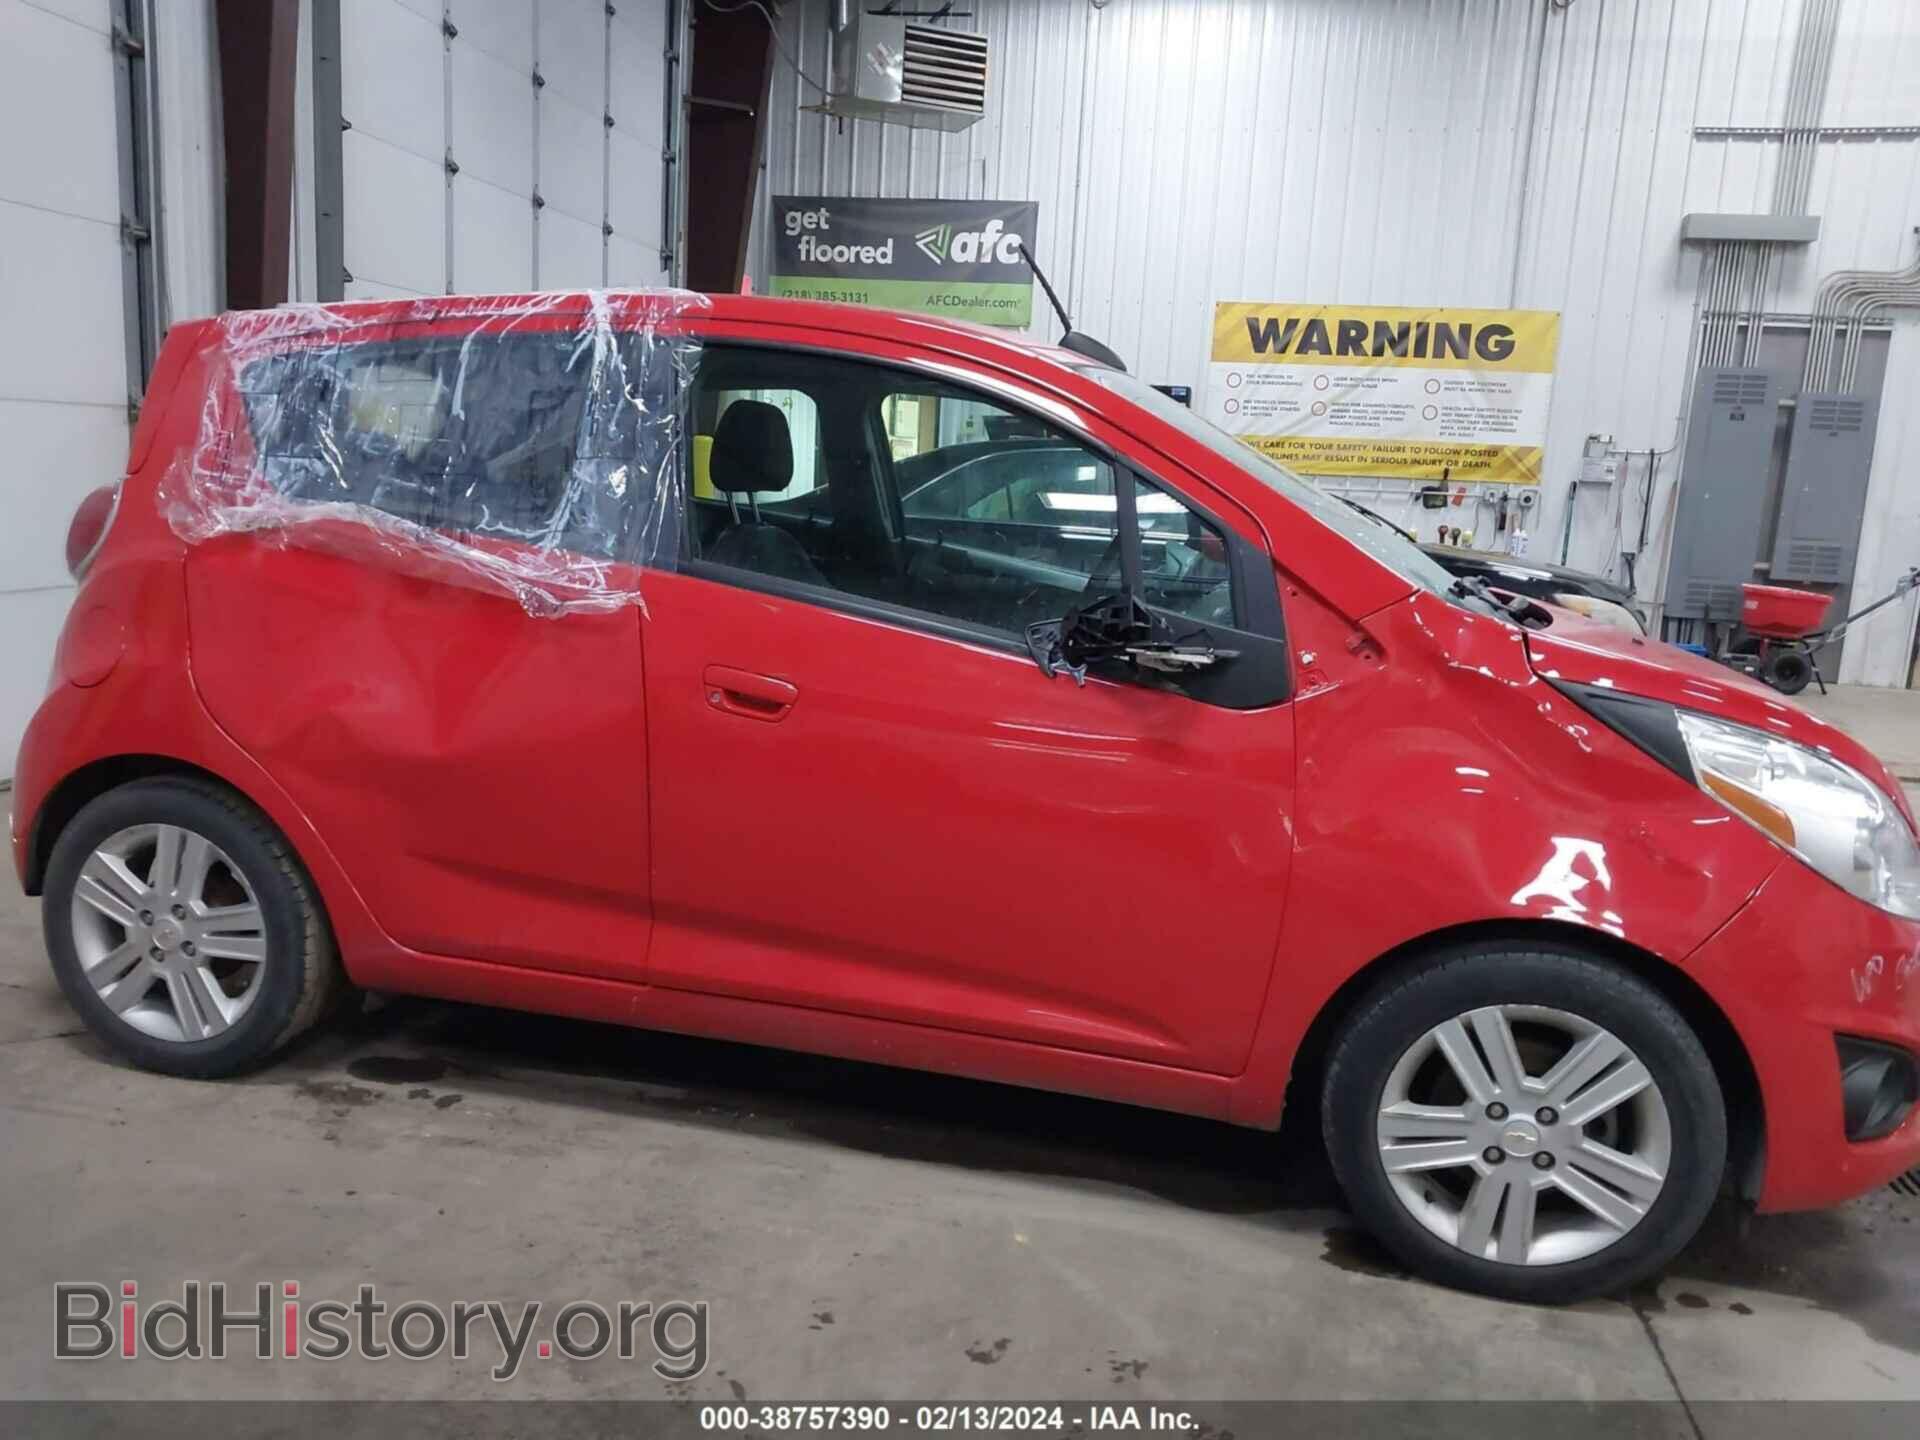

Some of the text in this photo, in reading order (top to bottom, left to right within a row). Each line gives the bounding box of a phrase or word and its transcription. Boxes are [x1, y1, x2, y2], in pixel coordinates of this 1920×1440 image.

[785, 207, 830, 236] get
[798, 235, 894, 265] floored
[815, 290, 869, 303] 385-3131
[926, 295, 1017, 308] AFCDealer.com
[1246, 316, 1516, 362] WARNING
[1263, 440, 1285, 449] CARE
[1288, 441, 1306, 449] FOR
[1309, 442, 1334, 451] YOUR
[1372, 444, 1406, 454] FAILURE
[1409, 446, 1422, 455] TO
[1424, 446, 1461, 456] FOLLOW
[1463, 449, 1498, 458] POSTED
[1302, 453, 1322, 461] MAY
[1325, 454, 1355, 463] RESULT
[1359, 455, 1368, 463] IN
[1371, 456, 1408, 465] SERIOUS
[1409, 458, 1443, 467] INJURY
[1446, 460, 1461, 468] OR
